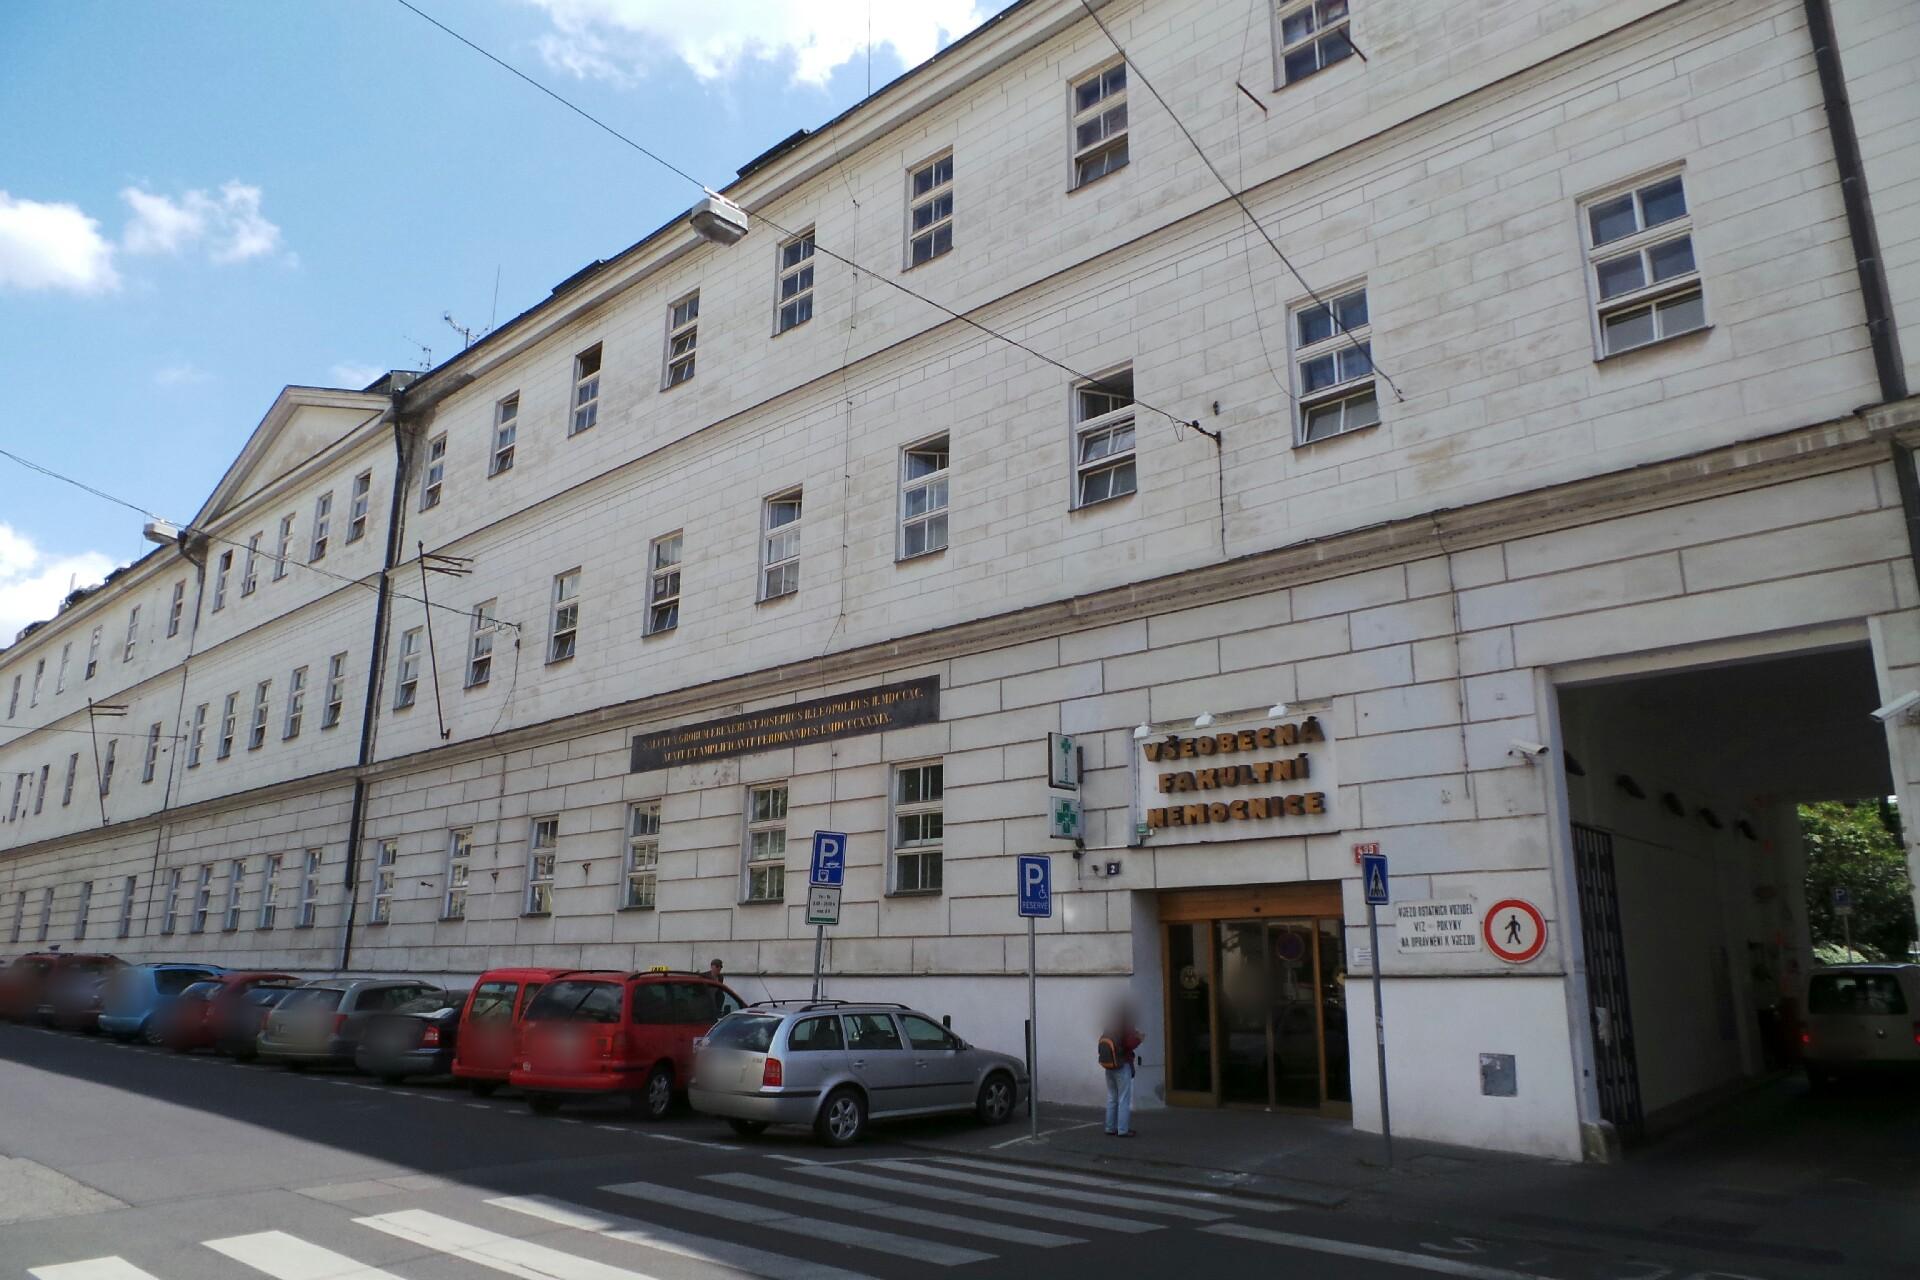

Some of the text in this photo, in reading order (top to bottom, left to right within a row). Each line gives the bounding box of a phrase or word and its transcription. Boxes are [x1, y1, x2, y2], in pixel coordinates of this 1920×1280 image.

[813, 697, 869, 718] LEOPOLDUS
[687, 747, 698, 758] ET
[757, 727, 819, 746] FERDINANDUS
[1142, 715, 1326, 762] VŠEOBECNÁ
[1158, 752, 1311, 793] FAKULTNÍ
[1147, 791, 1326, 828] NEMOCNICE
[819, 838, 839, 868] P
[1025, 863, 1044, 897] P
[1835, 888, 1845, 901] P
[1436, 919, 1462, 931] POKYNY
[1444, 935, 1450, 946] K
